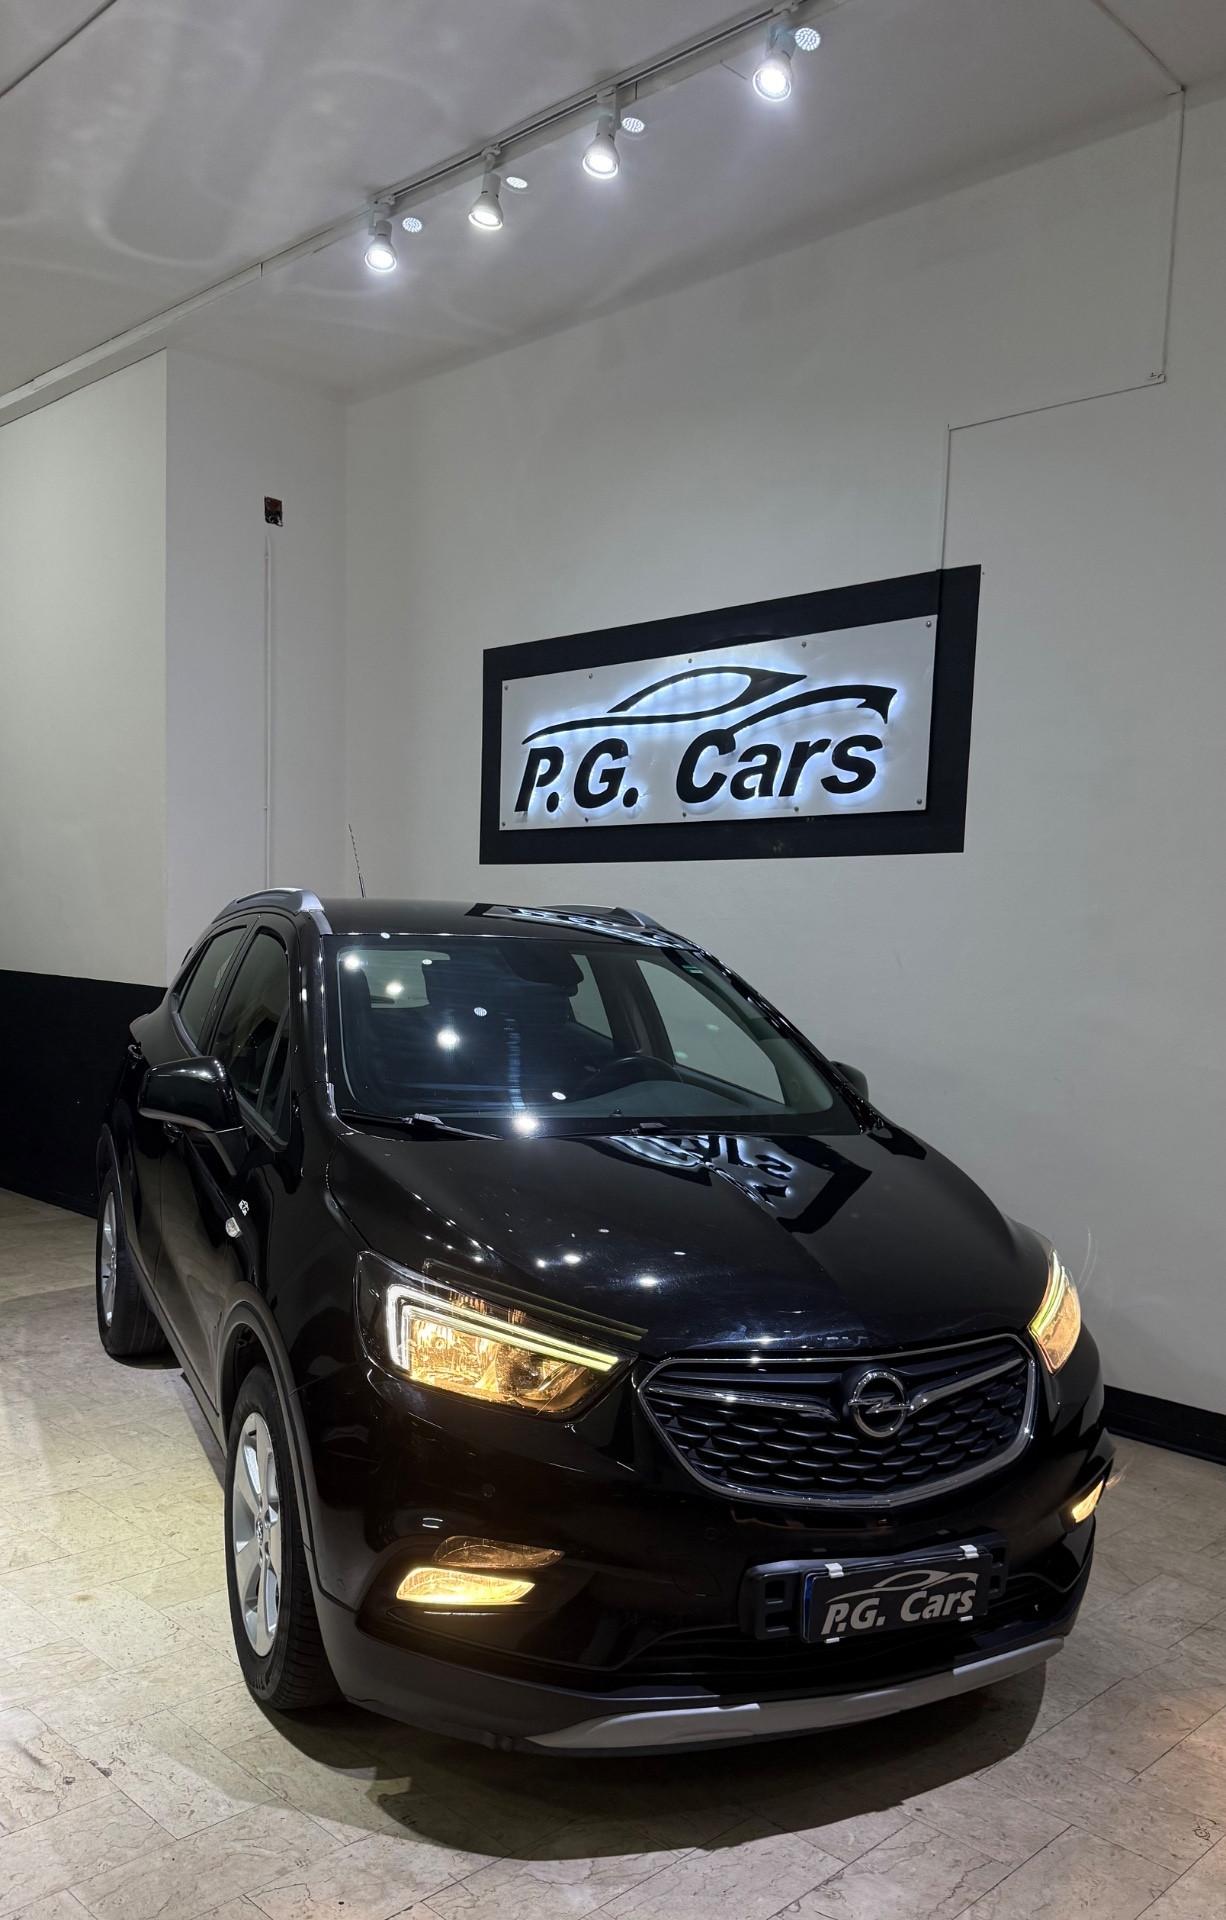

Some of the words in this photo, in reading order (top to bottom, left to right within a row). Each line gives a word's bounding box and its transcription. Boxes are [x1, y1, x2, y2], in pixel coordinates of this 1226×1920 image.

[515, 738, 639, 812] P.G.
[676, 729, 883, 804] Cars
[821, 1598, 886, 1635] P.G.
[900, 1589, 976, 1622] Cars
